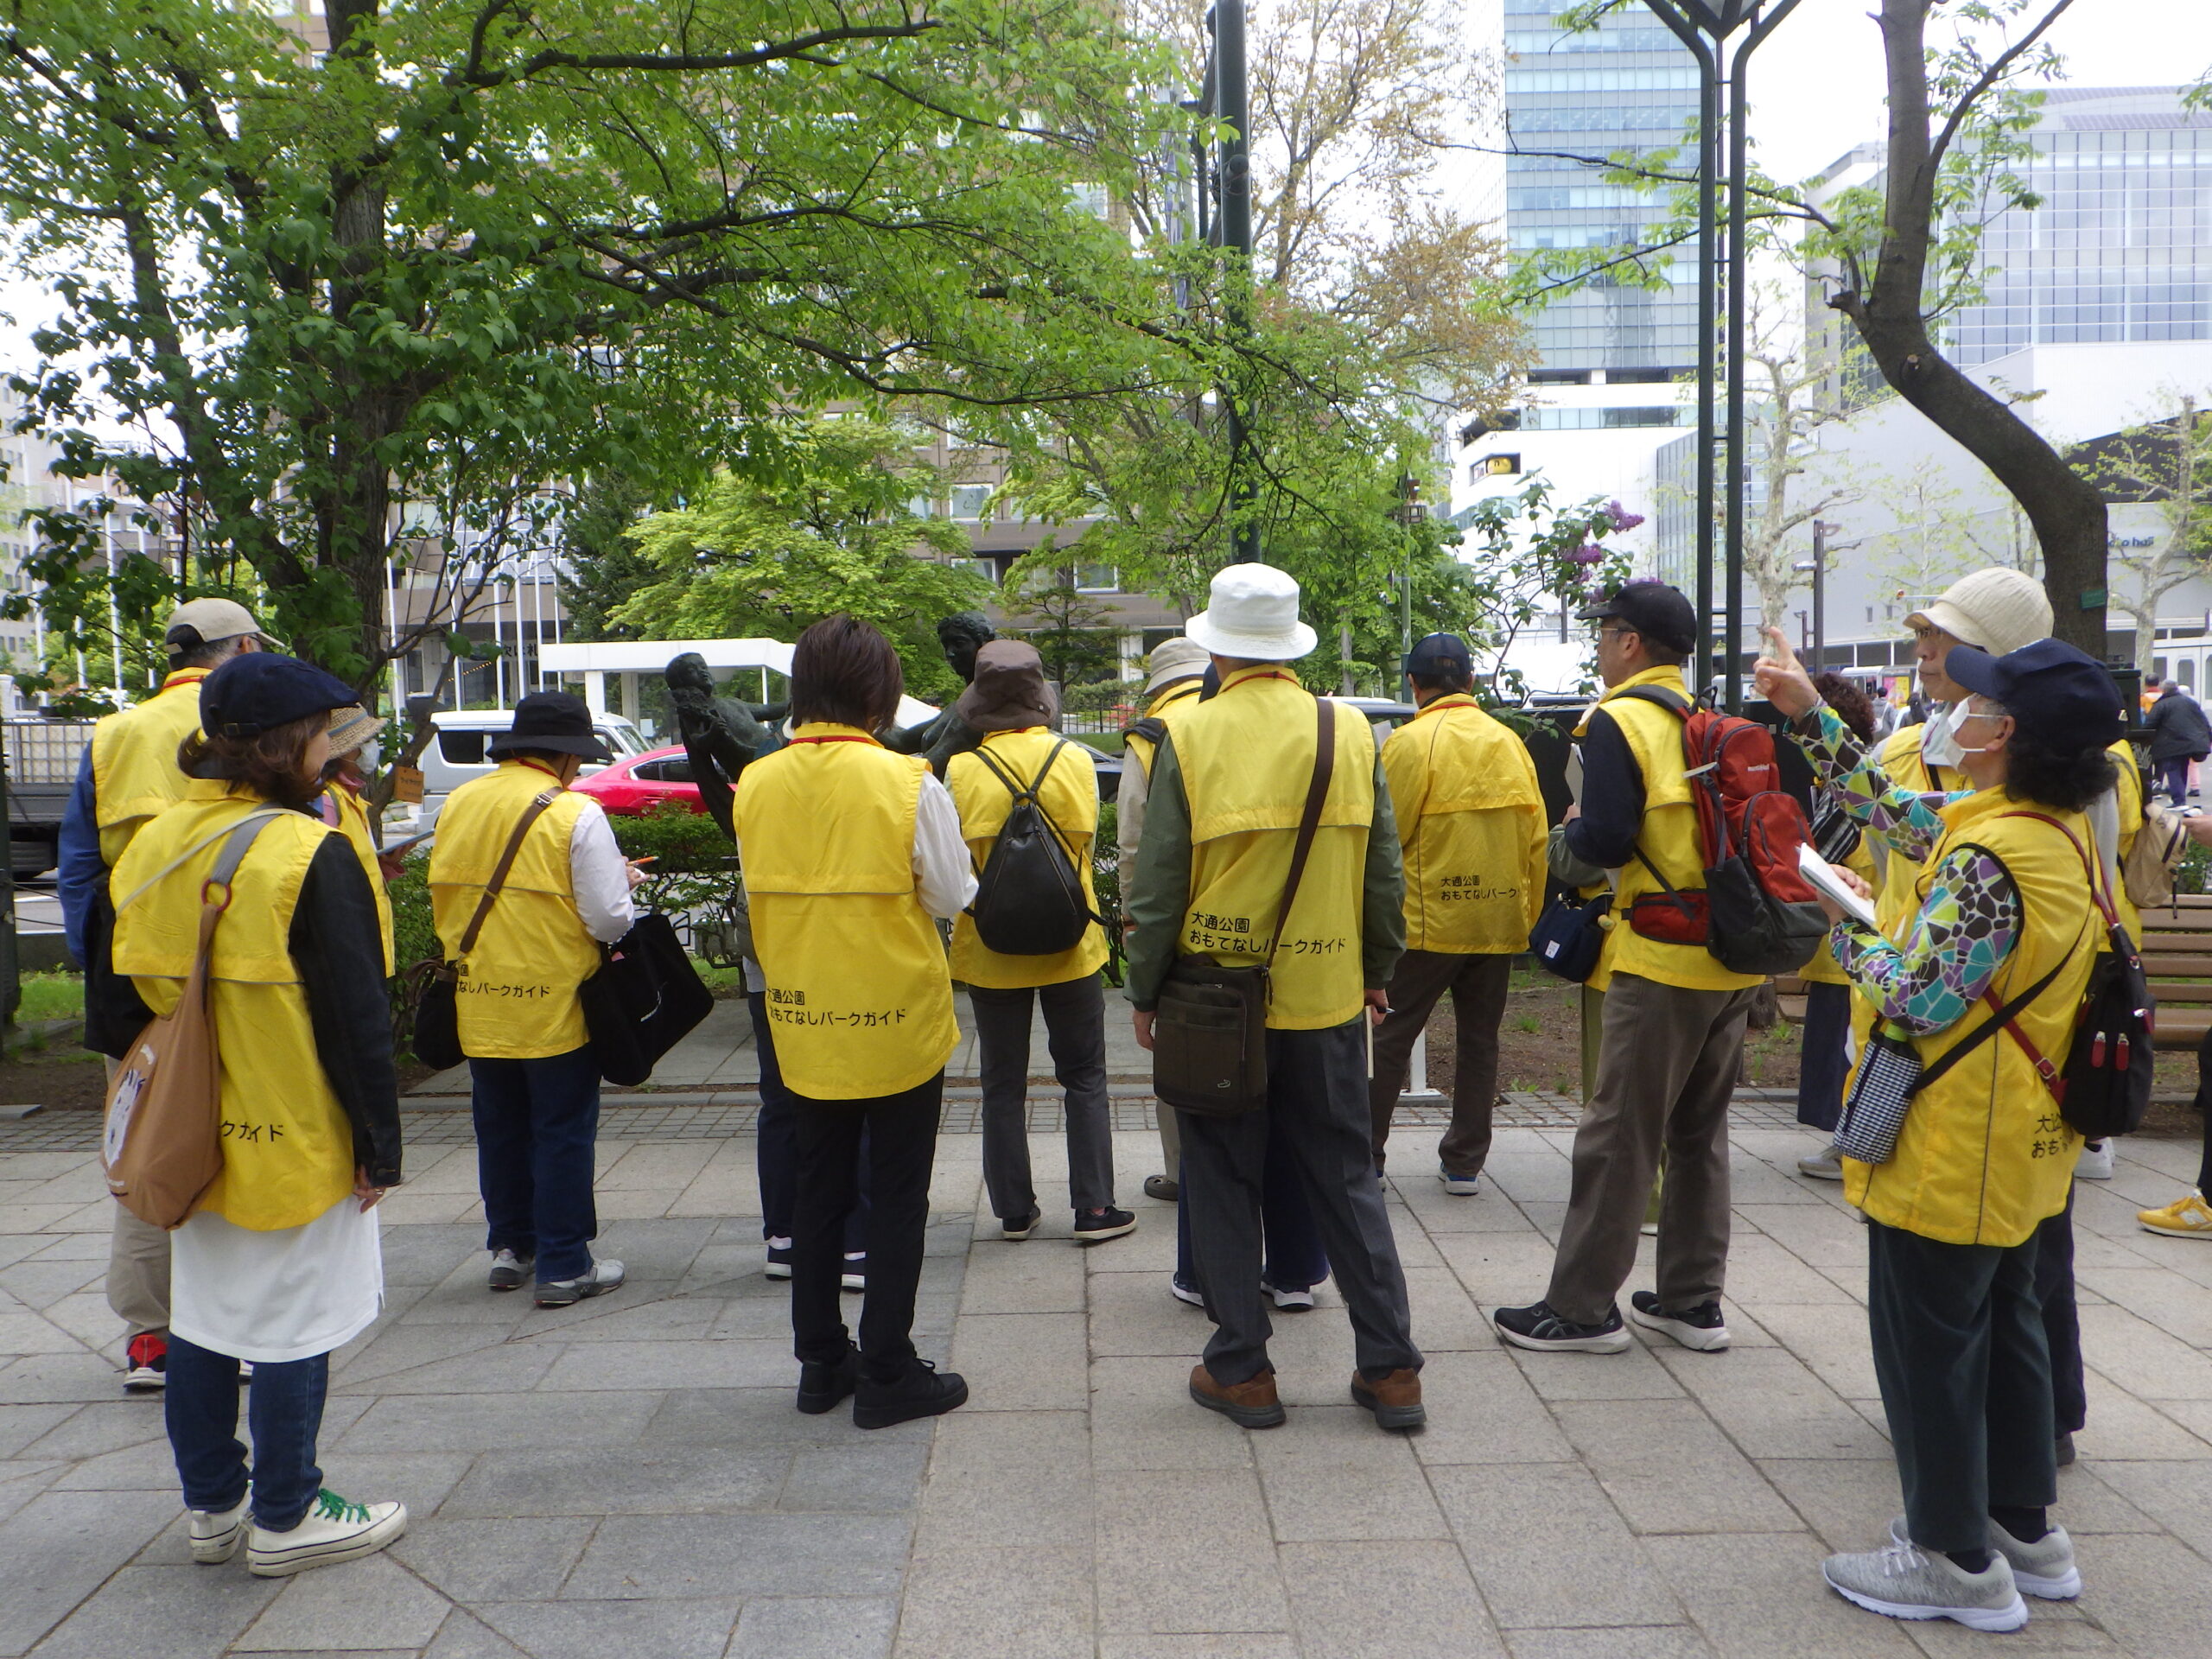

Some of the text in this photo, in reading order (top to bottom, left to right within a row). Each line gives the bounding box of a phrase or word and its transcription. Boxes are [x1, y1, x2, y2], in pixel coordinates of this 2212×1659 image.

[1440, 874, 1480, 887] 大通公園
[1440, 887, 1520, 900] おもてなしパーク
[1191, 911, 1250, 934] 大通公園
[456, 981, 550, 998] なしパークガイド
